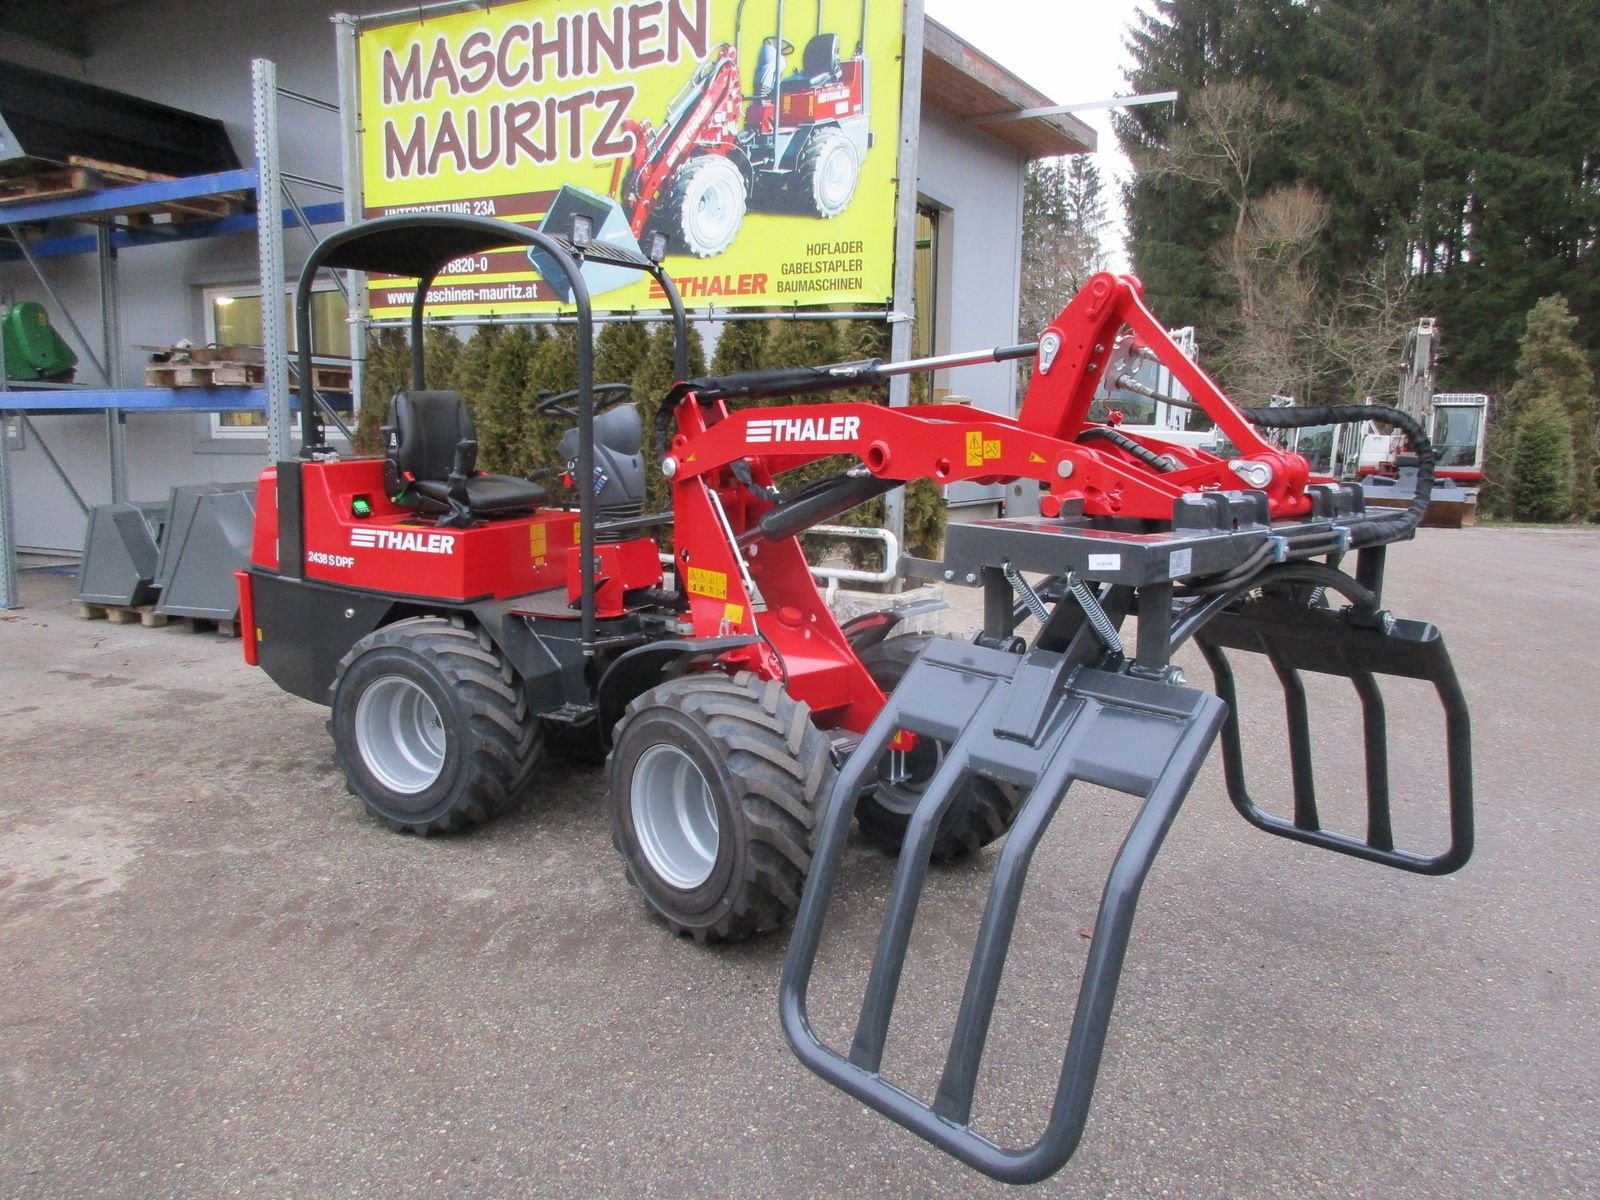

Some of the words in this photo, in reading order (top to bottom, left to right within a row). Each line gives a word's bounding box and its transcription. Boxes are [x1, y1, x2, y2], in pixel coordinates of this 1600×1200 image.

[383, 0, 707, 105] MASCHINEN
[385, 85, 635, 179] MAURITZ
[473, 199, 496, 216] 23A
[806, 240, 863, 256] HOFLADER
[781, 259, 863, 275] GABELSTAPLER
[678, 273, 768, 298] THALER
[777, 277, 863, 293] BAUMASCHINEN
[772, 416, 860, 442] THALER
[375, 530, 455, 554] THALER
[308, 551, 328, 564] 2438
[328, 554, 335, 566] S
[336, 556, 355, 568] DPF
